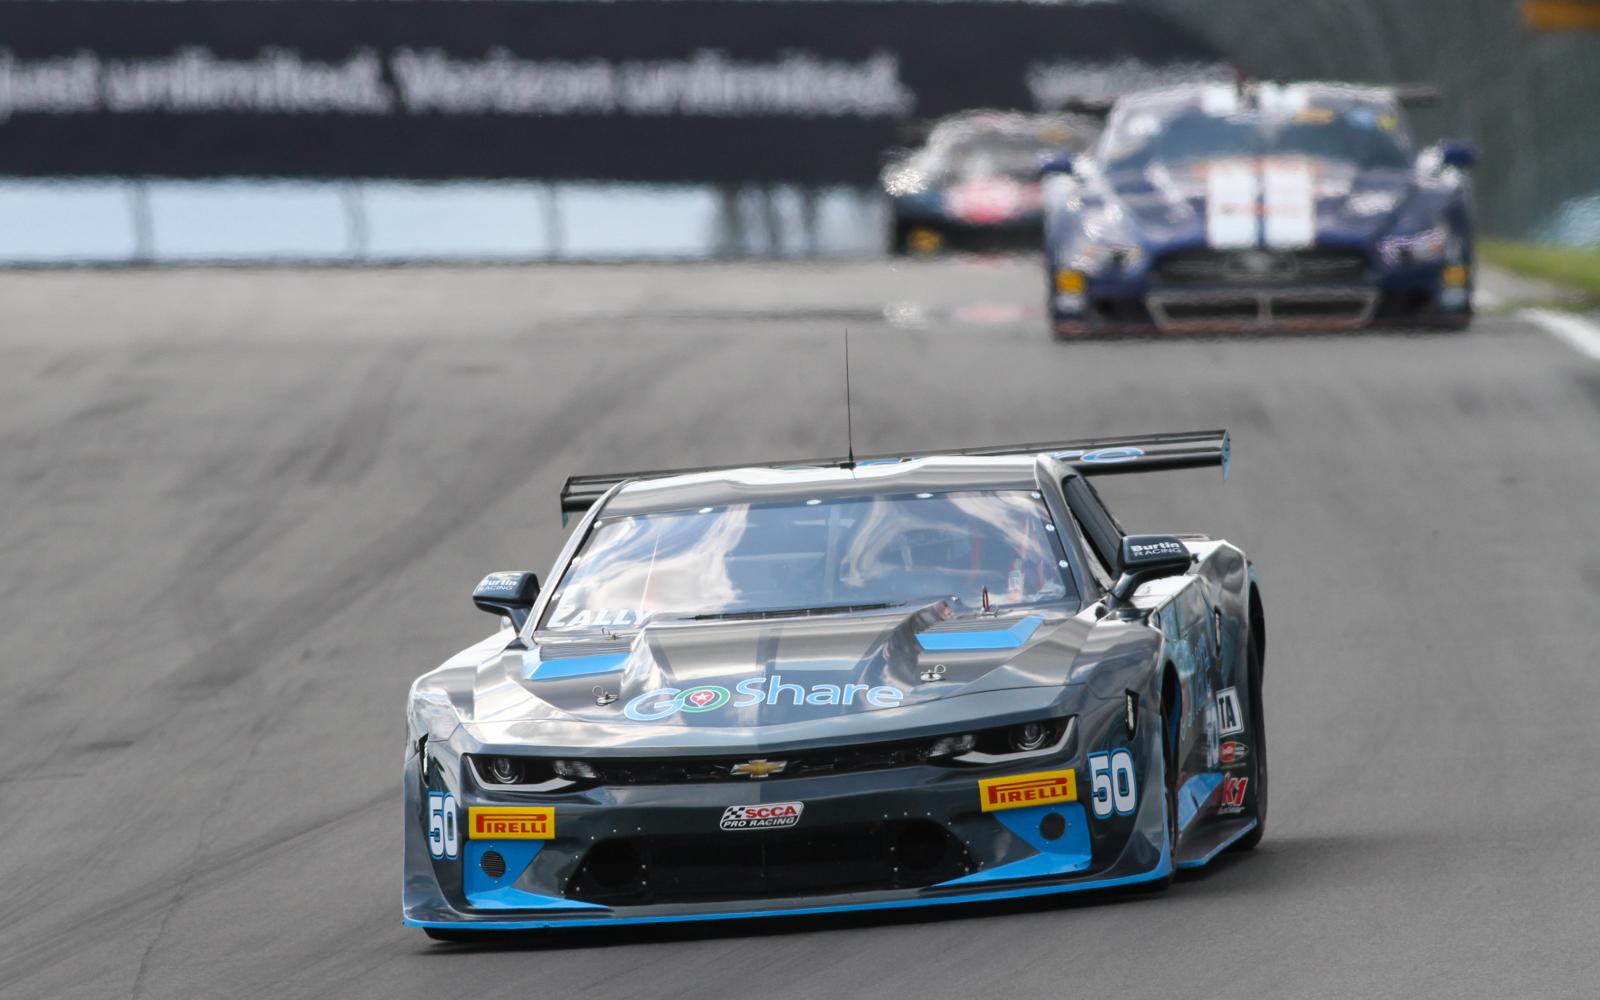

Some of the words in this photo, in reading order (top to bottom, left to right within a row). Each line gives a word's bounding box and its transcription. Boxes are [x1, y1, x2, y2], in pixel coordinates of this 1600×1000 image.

[1130, 542, 1180, 552] Burtin
[1134, 548, 1182, 557] RACING
[1218, 695, 1237, 729] TA
[987, 777, 1068, 804] PIRELLI
[1087, 747, 1138, 820] 50
[744, 805, 797, 819] SCCA
[428, 791, 458, 861] 50
[476, 814, 547, 833] PIRELLI
[723, 820, 747, 828] PRO
[748, 816, 795, 827] RACING
